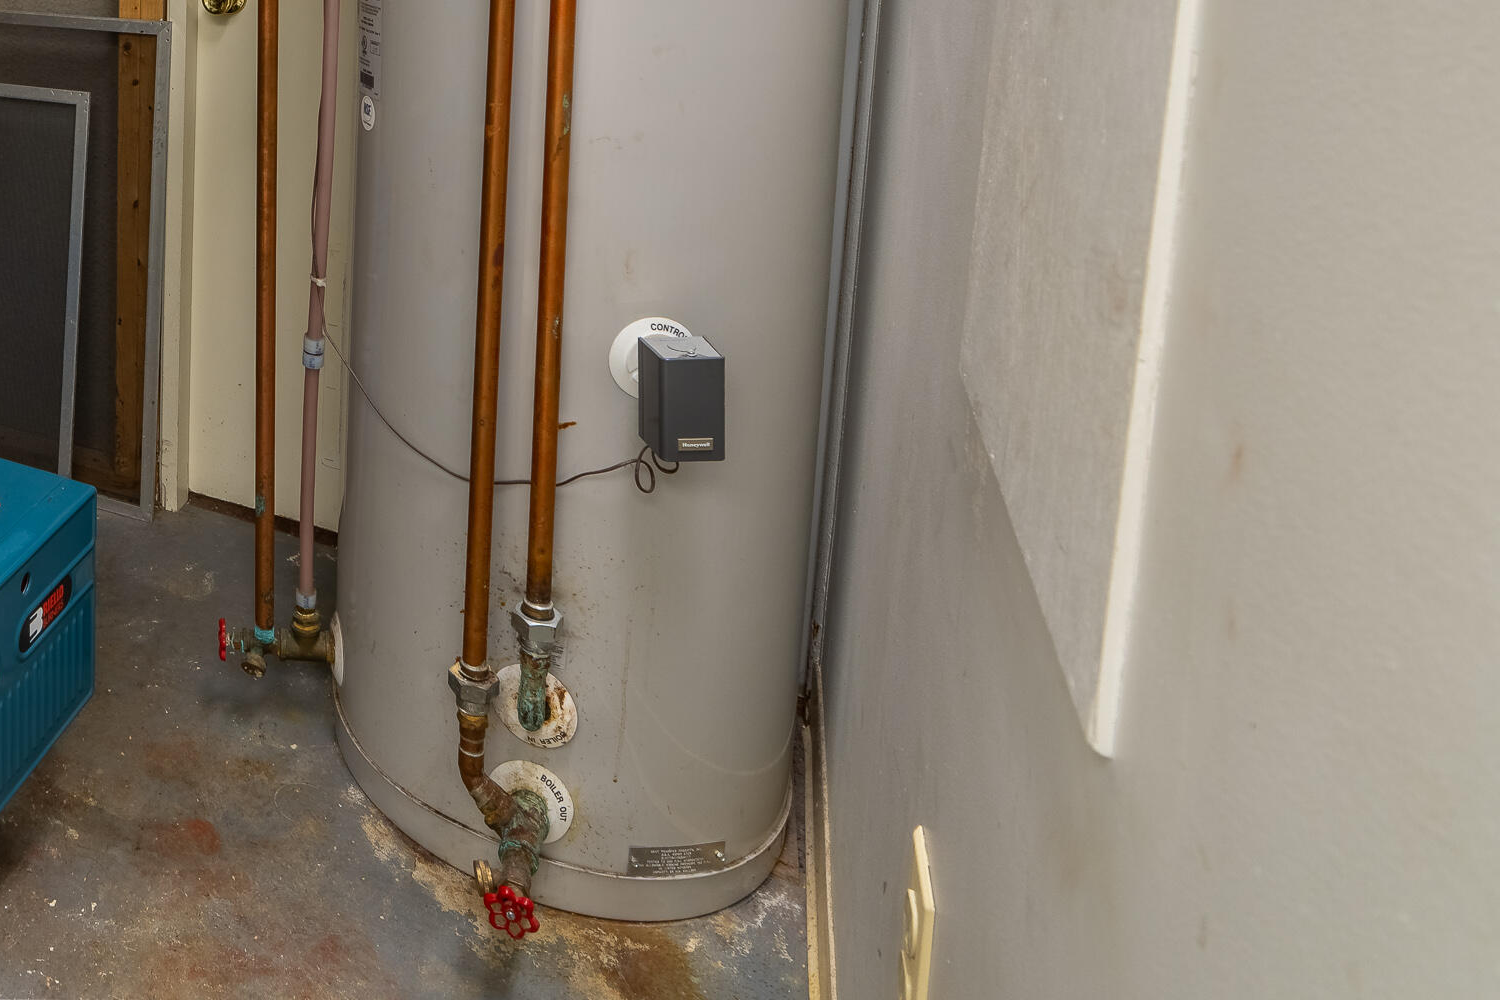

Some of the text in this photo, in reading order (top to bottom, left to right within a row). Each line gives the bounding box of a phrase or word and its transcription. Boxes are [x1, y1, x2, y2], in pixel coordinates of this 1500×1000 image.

[650, 323, 688, 338] CONTRO
[682, 441, 710, 449] Honeywell
[42, 584, 64, 614] RIELLO
[527, 731, 567, 745] BOILER IN
[540, 774, 567, 822] BOILER OUT
